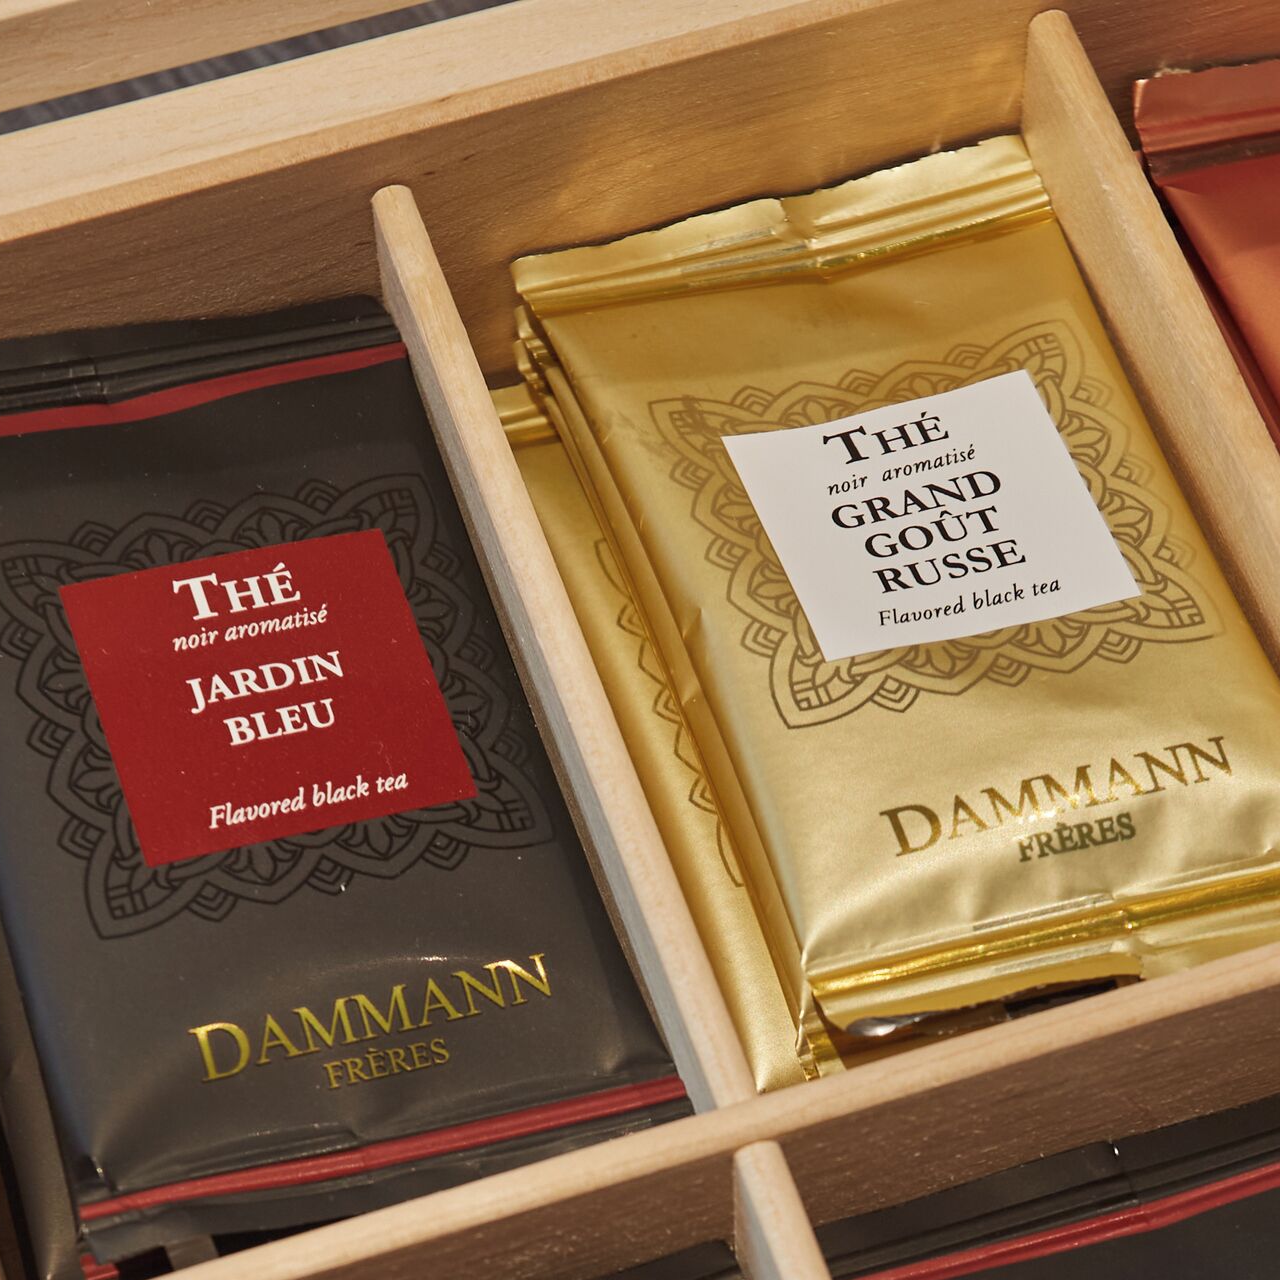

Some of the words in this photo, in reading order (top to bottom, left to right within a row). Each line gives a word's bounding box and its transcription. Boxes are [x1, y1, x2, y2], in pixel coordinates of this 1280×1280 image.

[823, 412, 949, 464] THÉ
[828, 473, 869, 496] noir
[882, 444, 976, 482] aromatisé
[831, 470, 1001, 529] GRAND
[864, 506, 999, 558] GOÛT
[172, 562, 301, 621] THÉ
[873, 539, 1026, 594] RUSSE
[879, 591, 965, 626] Flavored
[973, 584, 1025, 610] black
[1031, 576, 1061, 598] tea
[173, 627, 219, 652] noir
[225, 604, 329, 642] aromatisé
[186, 650, 345, 714] JARDIN
[223, 698, 336, 746] BLEU
[209, 787, 306, 829] Flavored
[313, 775, 370, 808] black
[376, 773, 408, 793] tea
[880, 735, 1233, 857] DAMMANN
[1018, 812, 1136, 863] FRÈRES
[188, 953, 552, 1082] DAMMANN
[324, 1038, 450, 1090] FRÈRES
